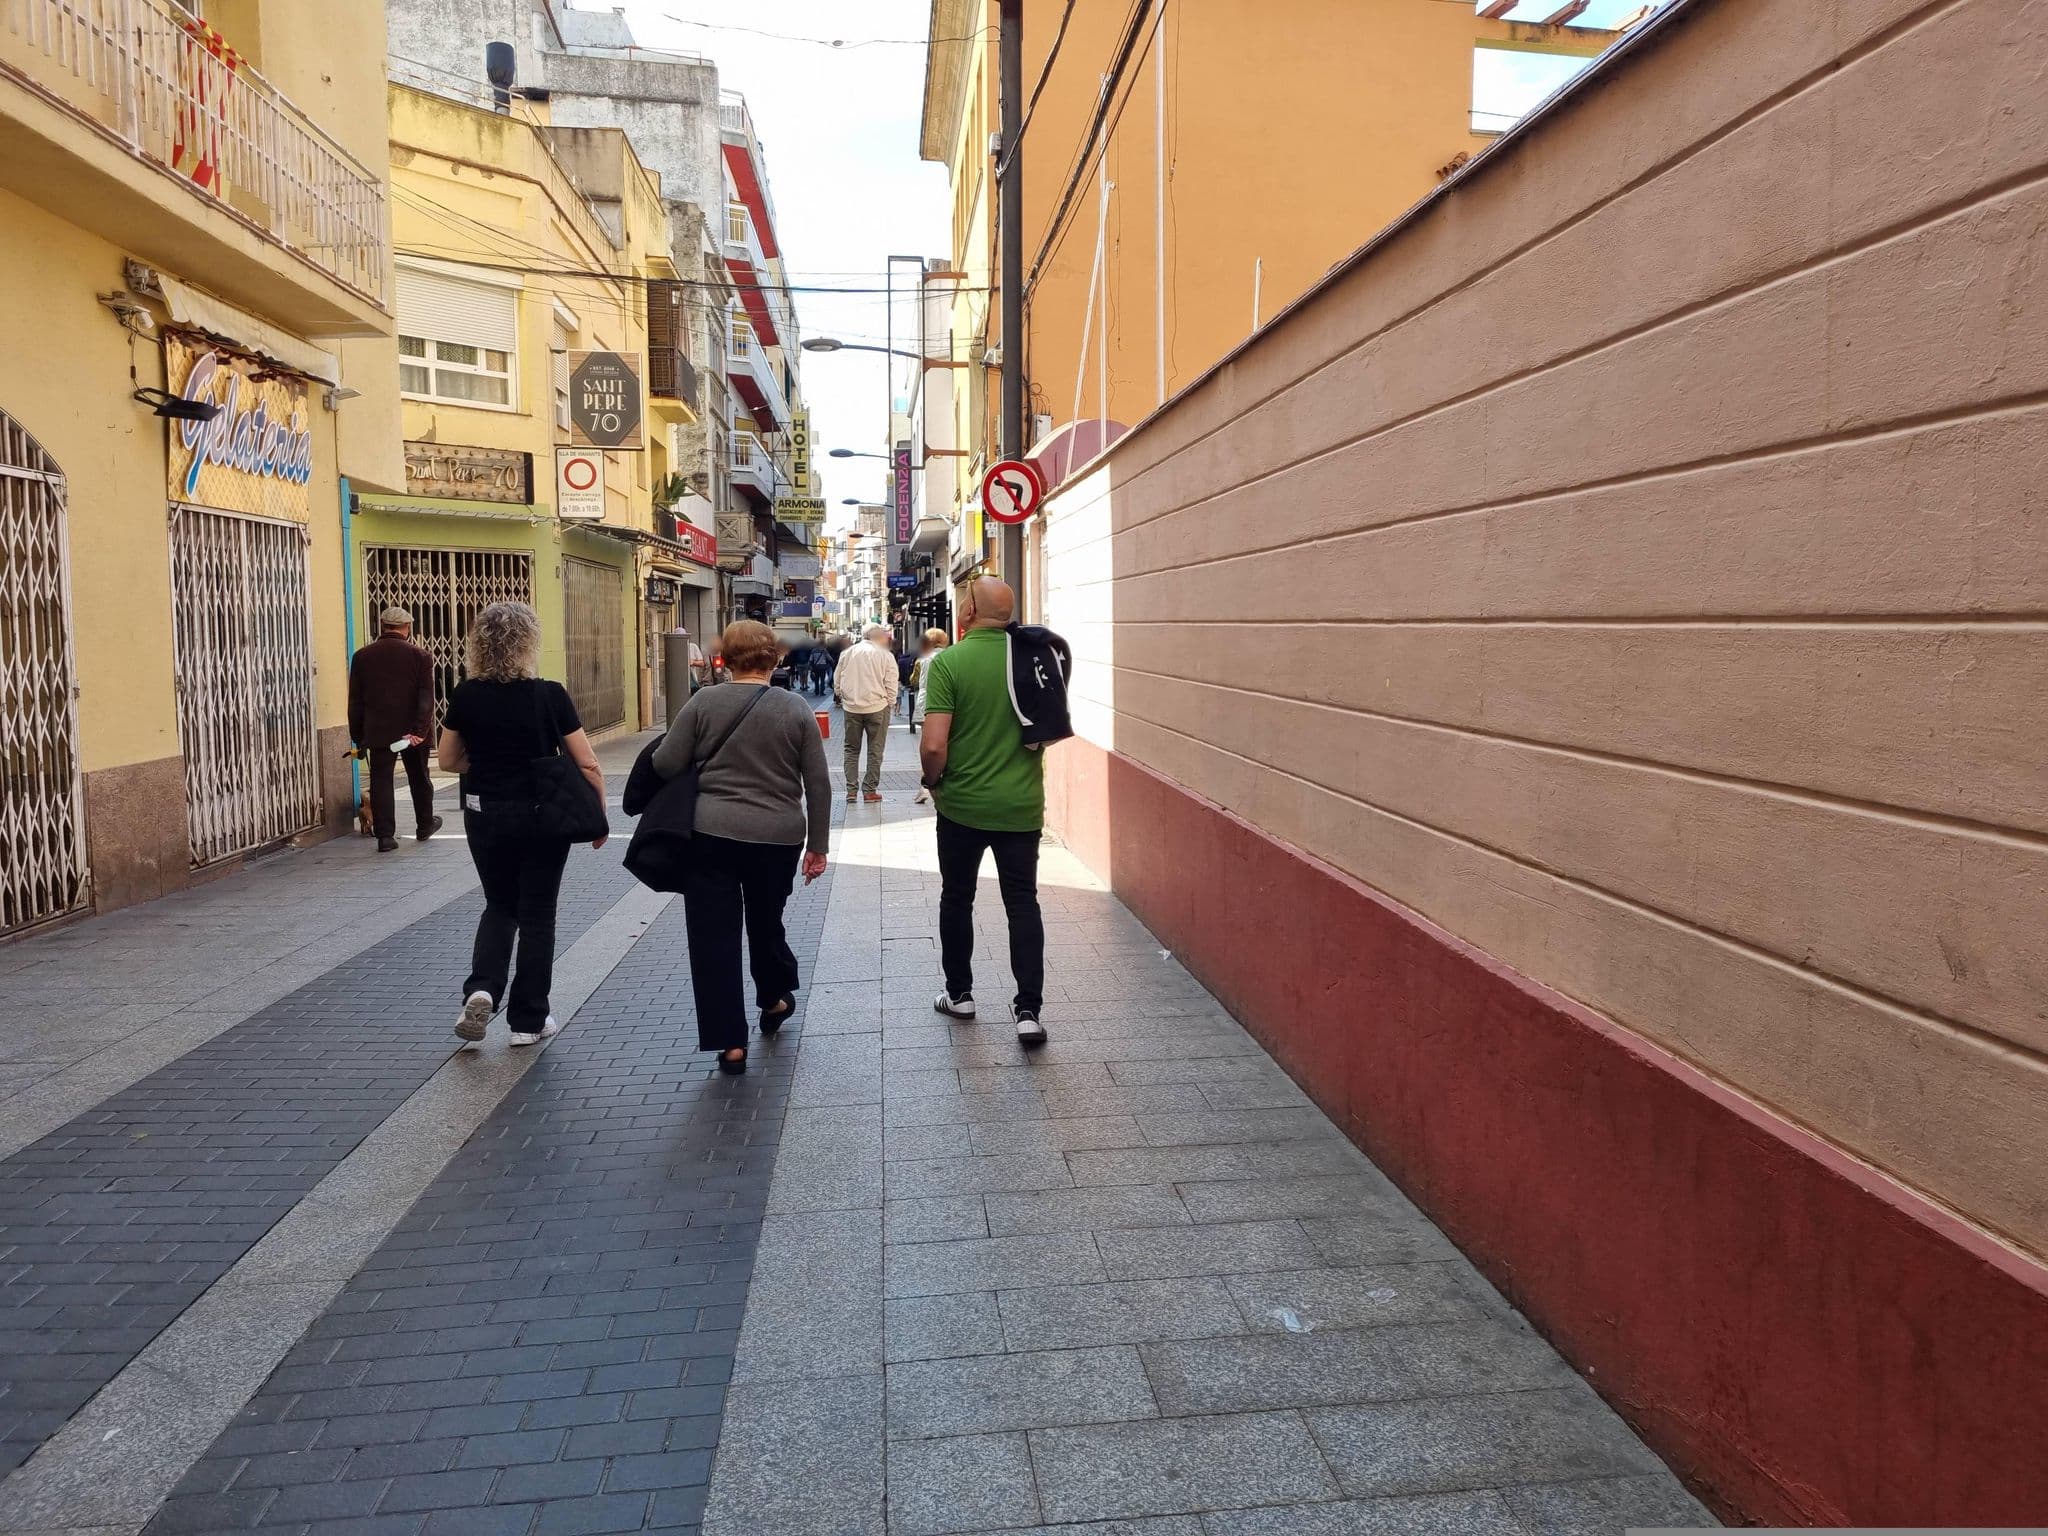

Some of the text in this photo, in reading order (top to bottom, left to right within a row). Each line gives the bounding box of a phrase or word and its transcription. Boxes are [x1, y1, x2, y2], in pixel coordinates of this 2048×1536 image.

[583, 379, 626, 393] SANT
[583, 393, 627, 411] PERE
[182, 352, 312, 501] Gelateria
[590, 412, 621, 432] 70
[793, 419, 806, 488] HOTEL
[404, 454, 519, 490] Sant Pere 70
[778, 499, 825, 508] ARMONIA
[898, 453, 910, 543] FOCENZA
